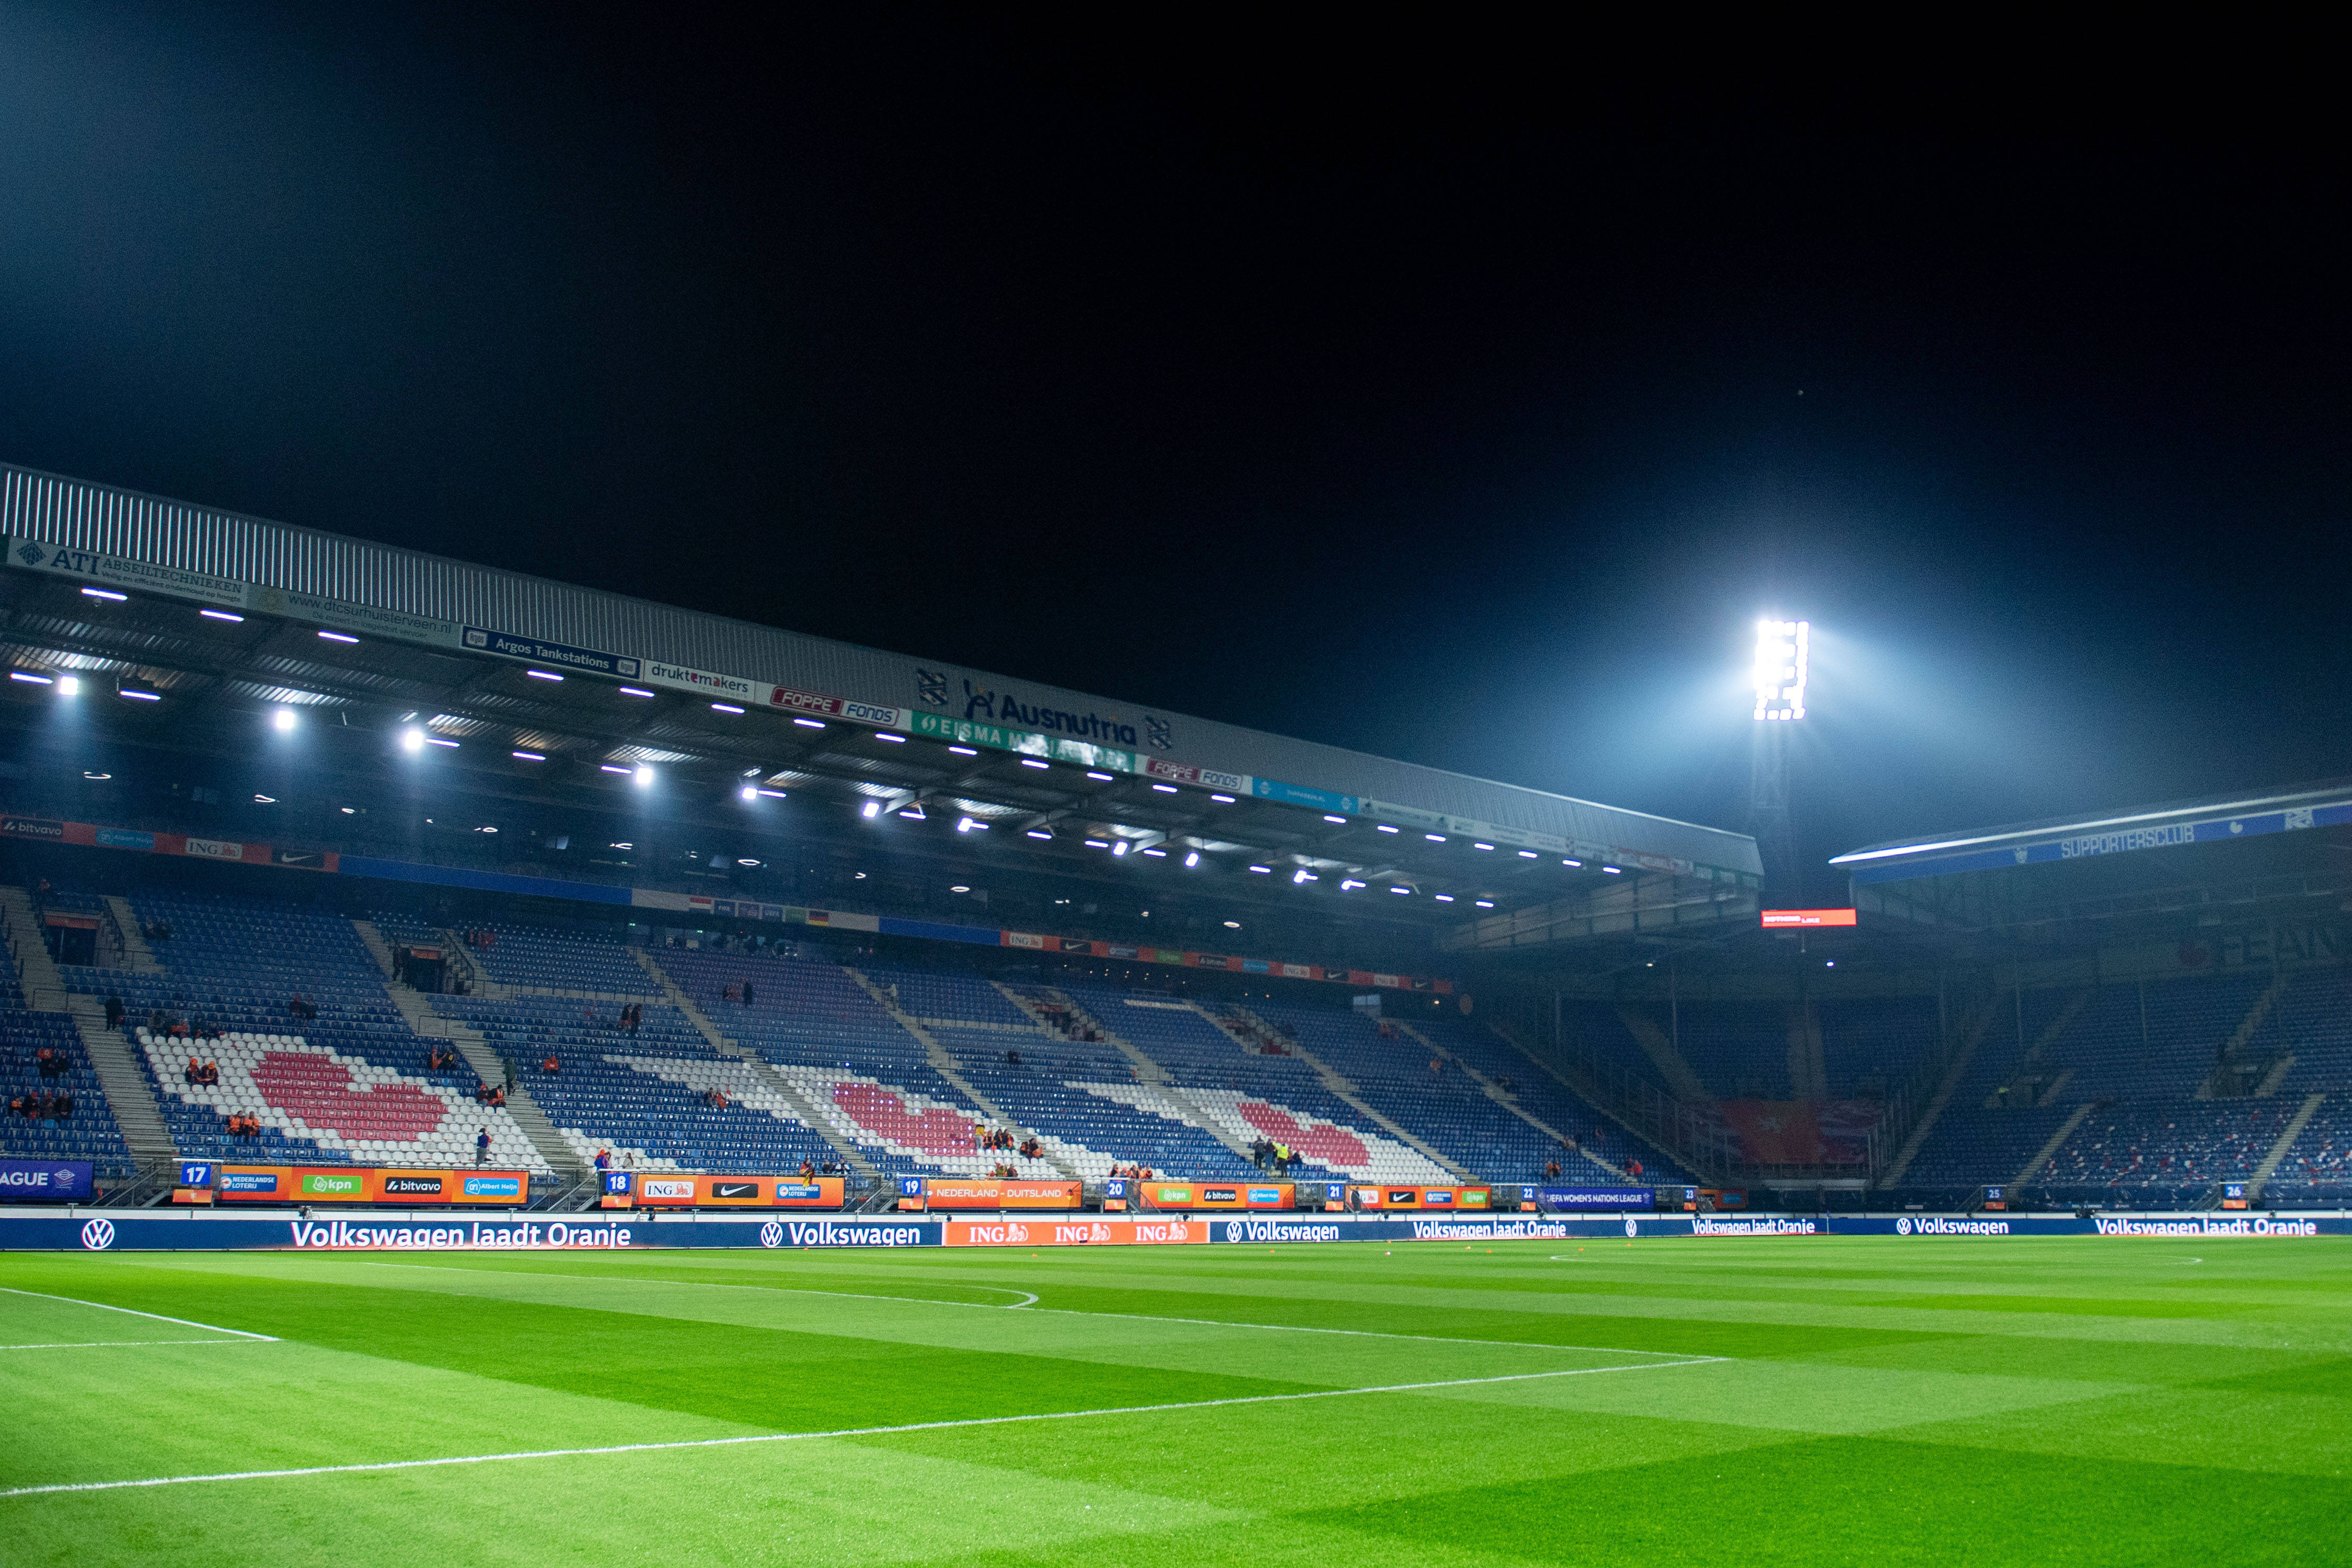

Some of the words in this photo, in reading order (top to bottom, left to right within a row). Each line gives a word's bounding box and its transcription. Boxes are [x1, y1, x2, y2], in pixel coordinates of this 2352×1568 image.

[50, 549, 100, 575] ATI
[103, 558, 241, 593] ABSEILTECHNIEKEN
[165, 583, 205, 596] onderhoud
[289, 594, 451, 634] www.dtcsurhuisterveen.nl
[496, 638, 532, 654] Argos
[535, 645, 609, 669] Tankstations
[651, 664, 748, 693] druktemakers
[782, 691, 833, 711] FOPPE
[846, 703, 892, 722] FONDS
[1000, 694, 1136, 745] Ausnutria
[941, 720, 1001, 744] EISMA
[1154, 763, 1193, 779] FOPPE
[1202, 773, 1238, 788] FONDS
[18, 821, 62, 836] bitvavo
[189, 843, 218, 855] ING
[2061, 825, 2195, 858] SUPPORTERSCLUB
[1011, 936, 1028, 945] ING
[187, 1167, 206, 1182] 17
[328, 1179, 352, 1191] kpn
[401, 1178, 441, 1191] bitvavo
[610, 1175, 626, 1190] 18
[648, 1185, 672, 1195] ING
[905, 1180, 918, 1193] 19
[1109, 1183, 1122, 1195] 20
[937, 1189, 998, 1197] NEDERLAND
[1172, 1192, 1186, 1200] kpn
[1213, 1191, 1235, 1200] bitvavo
[1330, 1186, 1340, 1197] 21
[1524, 1188, 1533, 1198] 22
[1686, 1190, 1694, 1199] 23
[1989, 1190, 2000, 1198] 25
[2228, 1186, 2241, 1196] 26
[789, 1222, 920, 1247] Volkswagen
[970, 1227, 1005, 1242] ING
[1055, 1227, 1088, 1242] ING
[1136, 1226, 1168, 1241] ING
[1246, 1221, 1339, 1242] Volkswagen
[1413, 1221, 1491, 1239] Volkswagen
[1493, 1221, 1525, 1237] laadt
[1527, 1220, 1566, 1238] Oranje
[1692, 1219, 1751, 1235] Volkswagen
[1752, 1219, 1777, 1234] laadt
[1778, 1219, 1815, 1235] Oranje
[1914, 1218, 2009, 1236] Volkswagen
[2095, 1219, 2199, 1236] Volkswagen
[2203, 1219, 2250, 1234] laadt
[2254, 1218, 2317, 1237] Oranje
[291, 1221, 464, 1249] Volkswagen
[472, 1222, 541, 1246] laadt
[548, 1223, 631, 1248] Oranje
